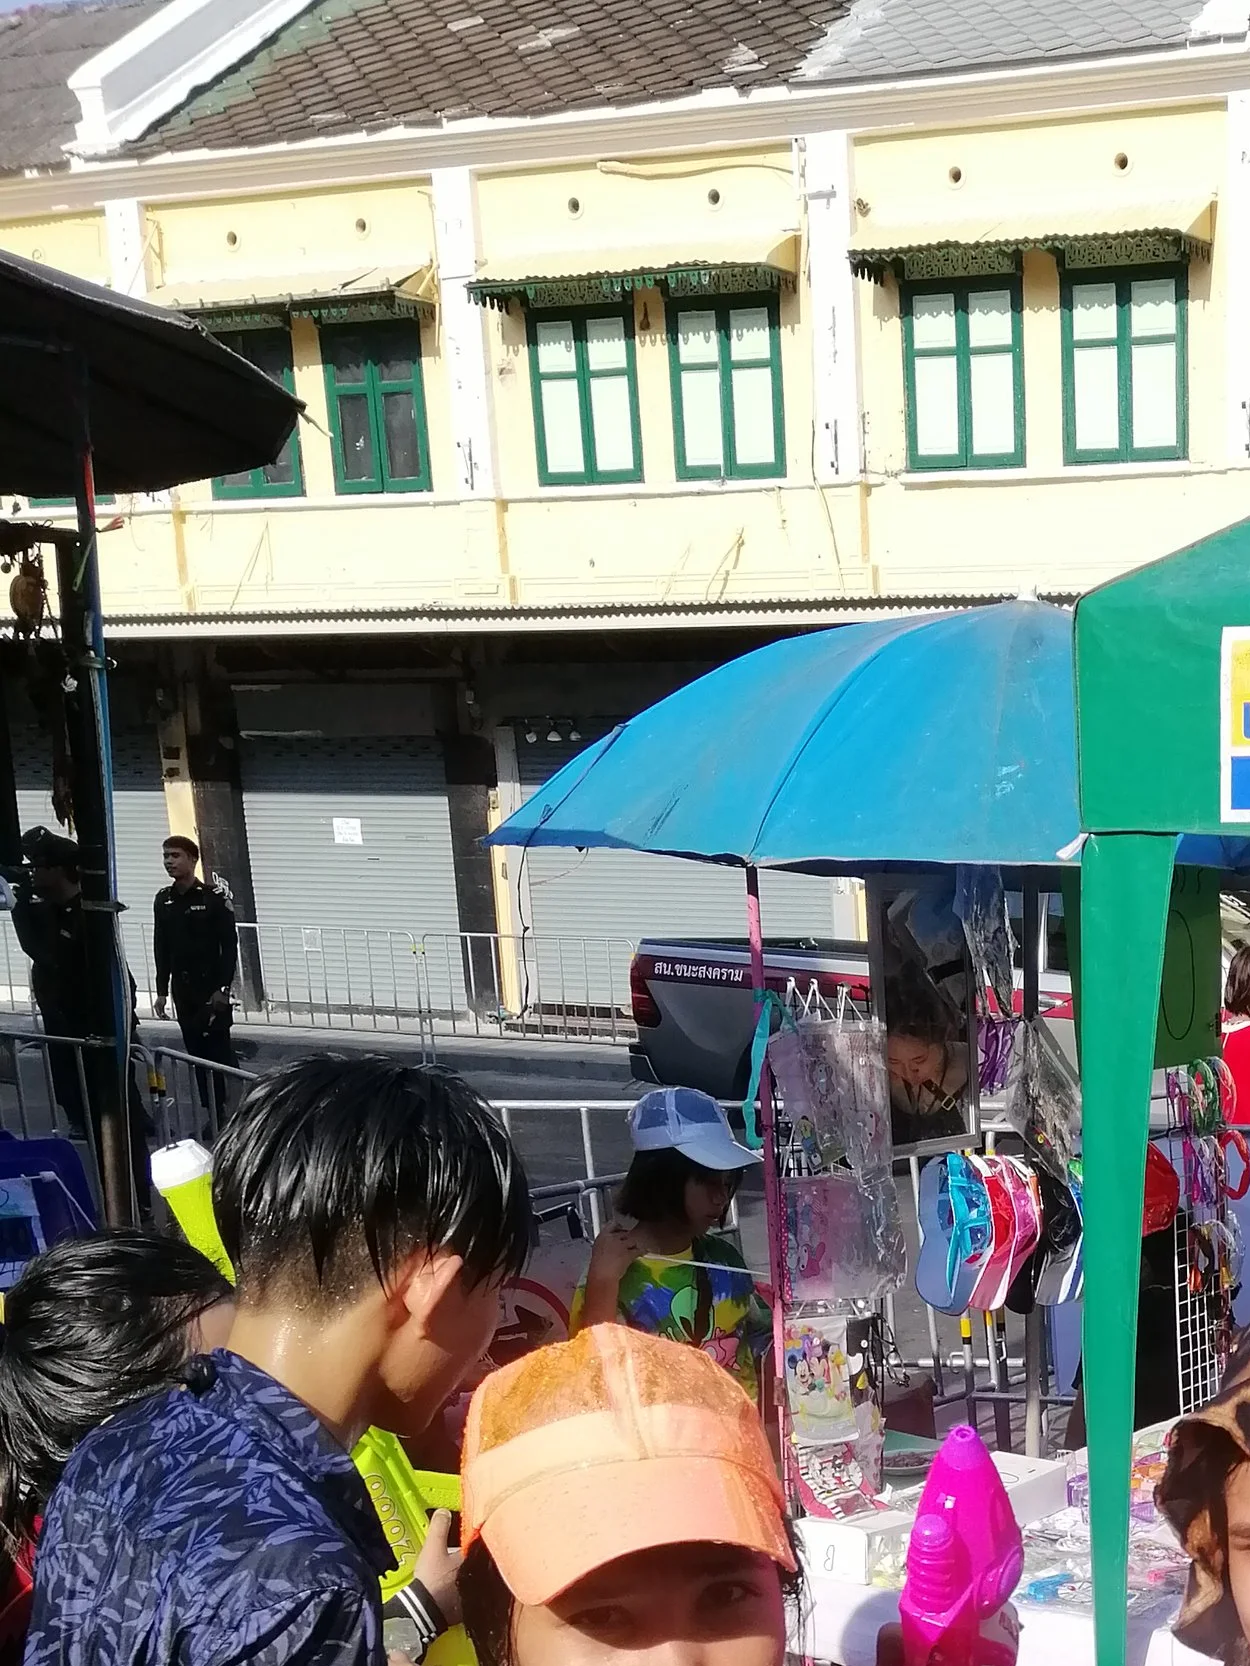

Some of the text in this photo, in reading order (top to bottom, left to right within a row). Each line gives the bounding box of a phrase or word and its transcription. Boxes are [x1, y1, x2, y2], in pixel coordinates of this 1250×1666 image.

[654, 961, 744, 982] สน.ชนะสงคราม
